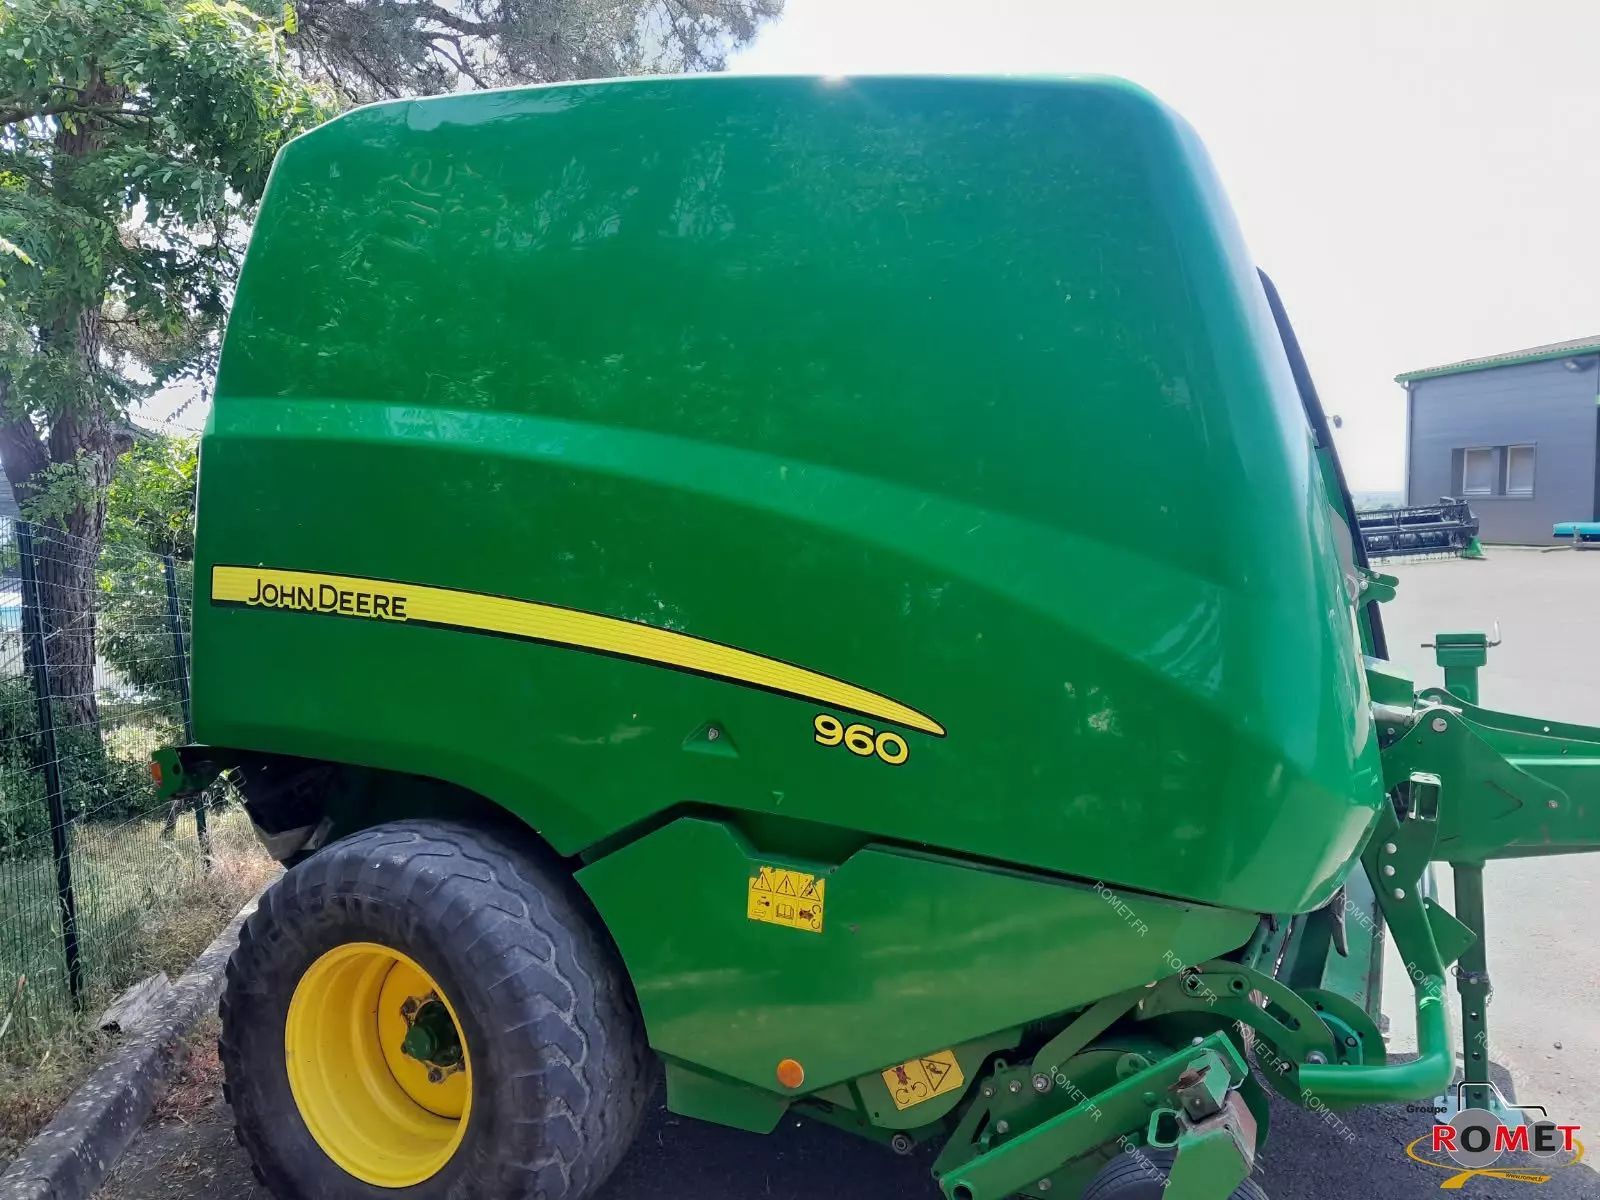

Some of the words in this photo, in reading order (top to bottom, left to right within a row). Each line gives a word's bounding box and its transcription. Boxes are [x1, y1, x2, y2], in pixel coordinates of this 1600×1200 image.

[249, 579, 314, 607] JOHN
[319, 584, 407, 617] DEERE
[814, 713, 909, 765] 960
